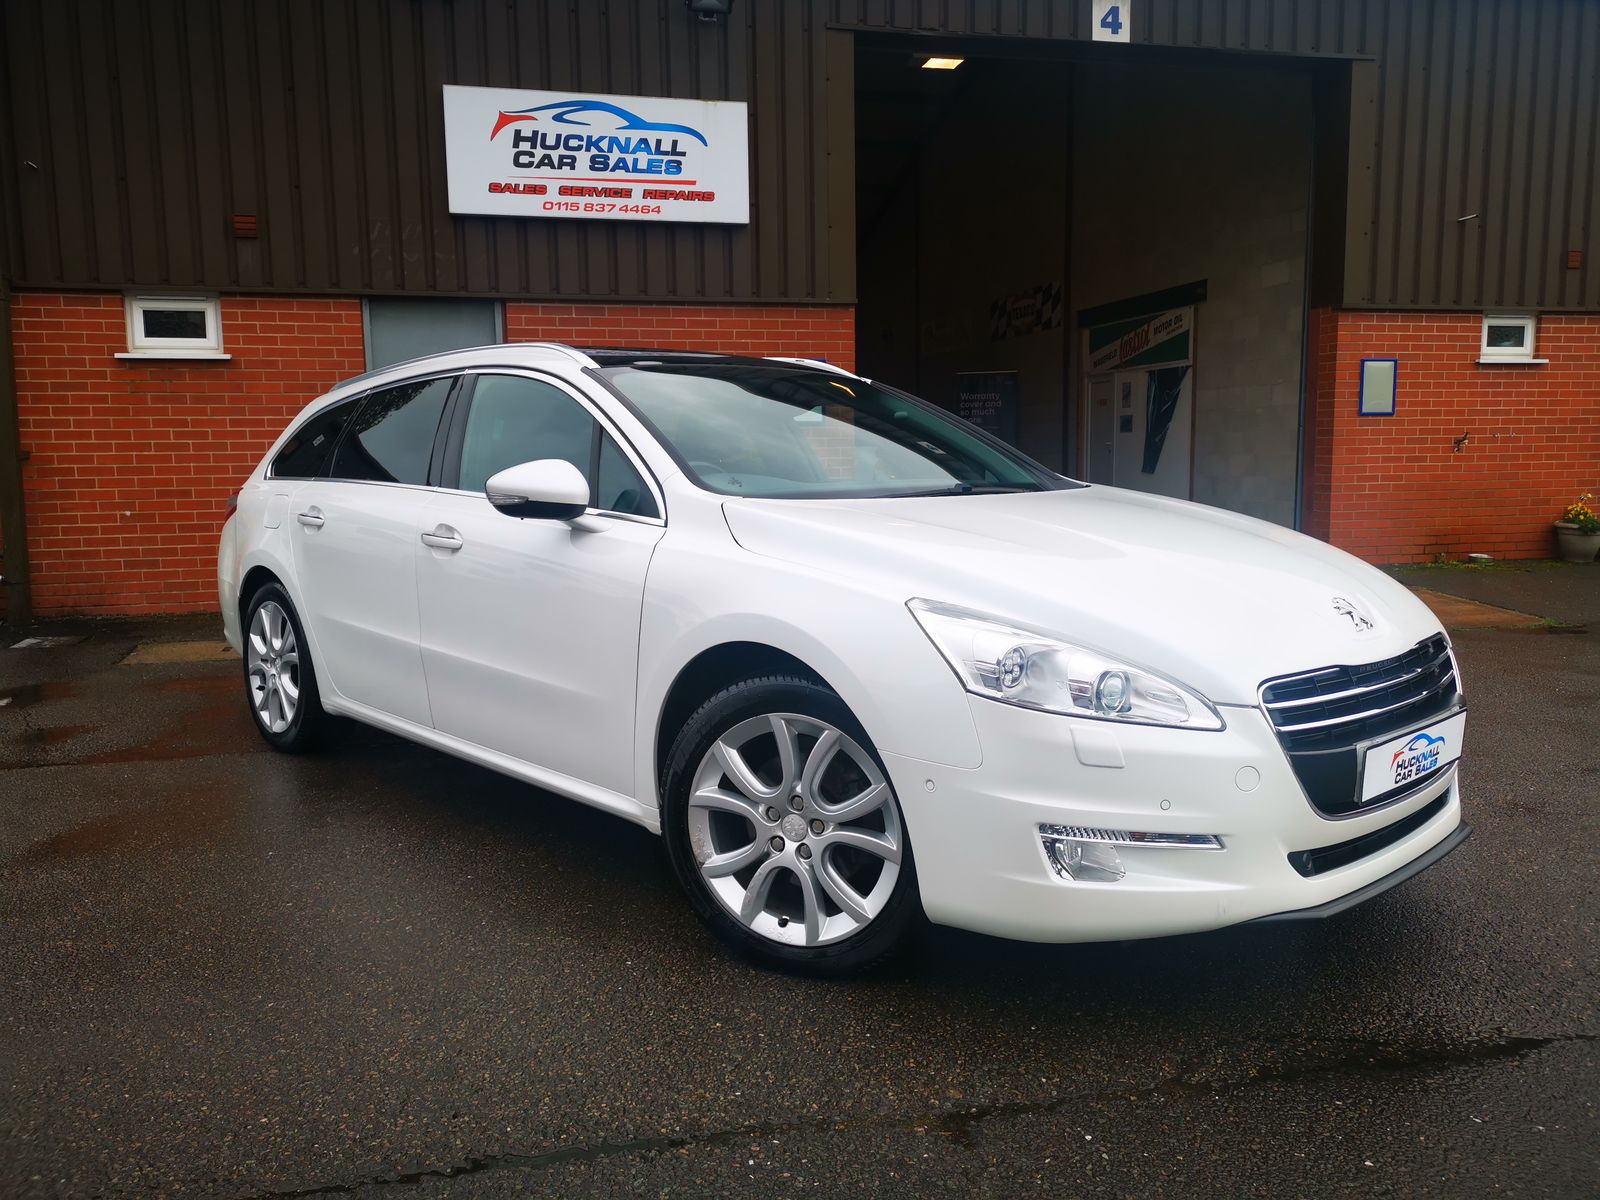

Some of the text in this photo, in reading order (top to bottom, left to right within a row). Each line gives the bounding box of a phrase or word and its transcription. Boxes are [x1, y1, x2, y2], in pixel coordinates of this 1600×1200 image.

[1101, 6, 1122, 34] 4
[512, 129, 687, 157] HUCKNALL
[512, 151, 682, 175] CAR SALES
[488, 182, 715, 202] SALES SERVICE REPAIRS
[543, 201, 661, 214] 0115 837 4464
[1153, 318, 1172, 336] MOTOR
[1174, 313, 1183, 325] OIL
[960, 393, 1001, 401] Warranty
[985, 400, 1002, 408] and
[972, 408, 995, 416] much
[1359, 659, 1396, 673] PEUGEO
[1395, 745, 1440, 773] HUCKNALL
[1394, 757, 1438, 785] CAR SALES
